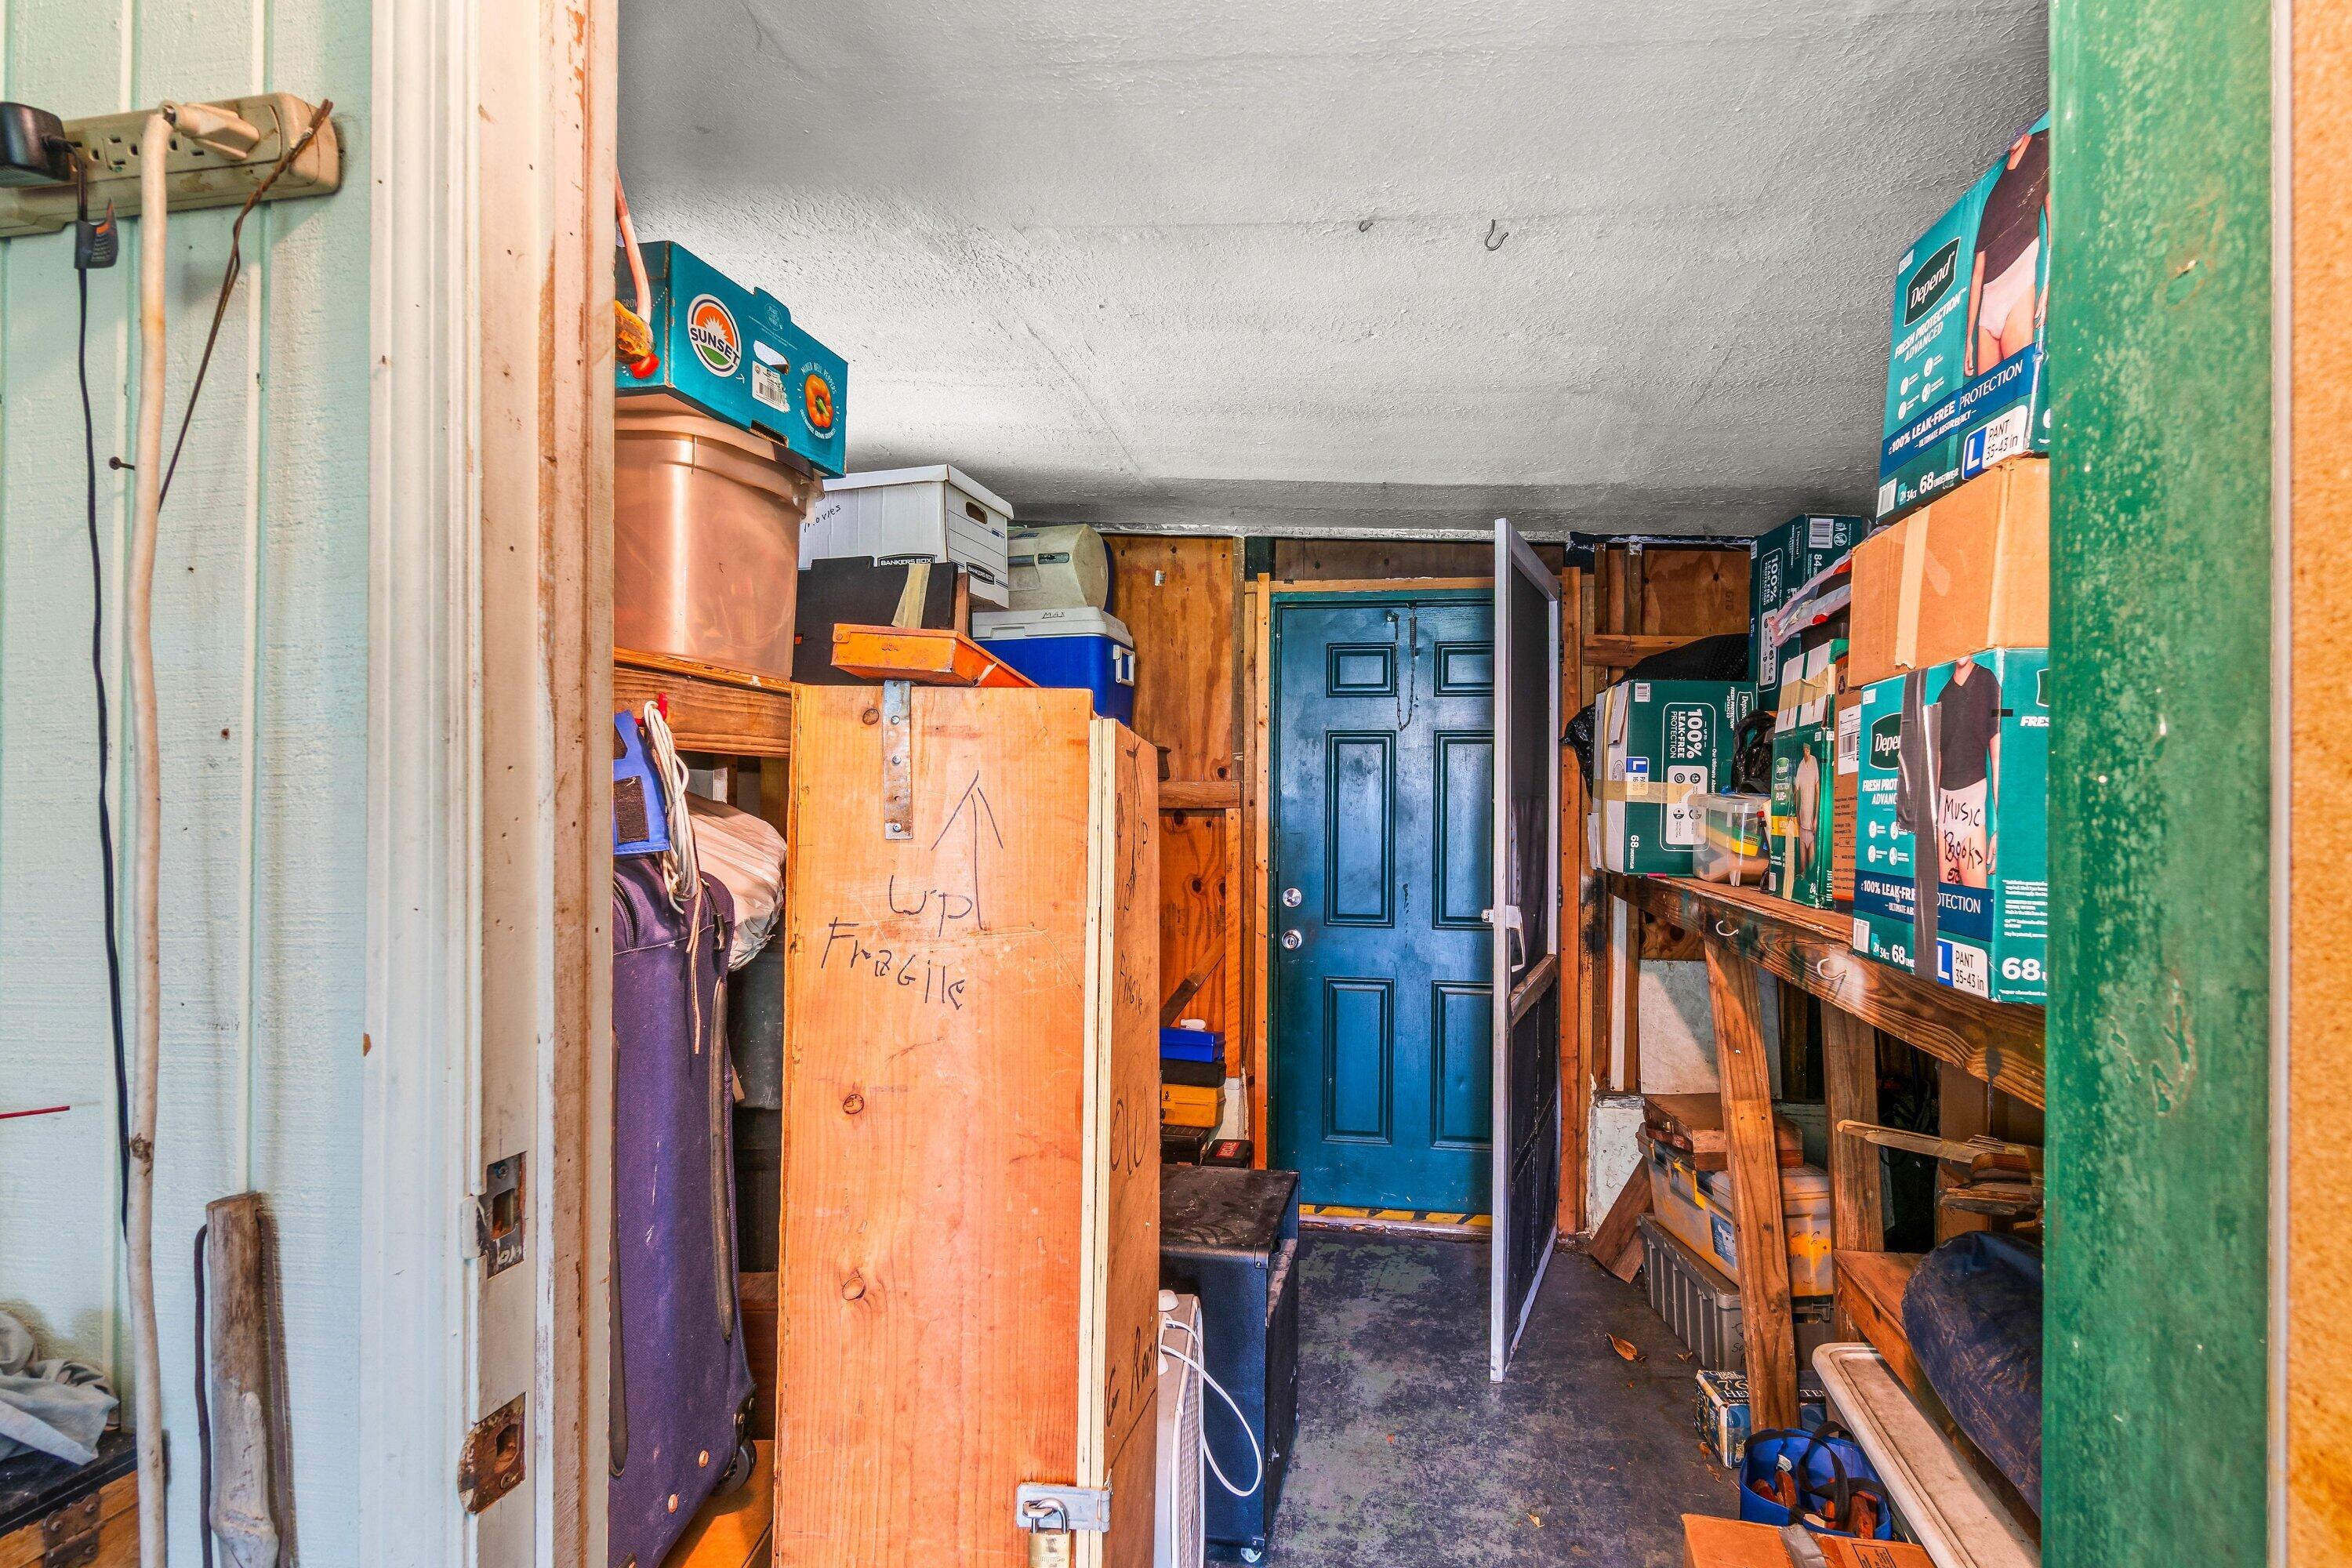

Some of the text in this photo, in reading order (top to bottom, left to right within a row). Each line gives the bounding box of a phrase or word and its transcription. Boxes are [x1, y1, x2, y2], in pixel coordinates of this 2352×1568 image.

[1910, 257, 1952, 309] Depend
[1894, 292, 1962, 360] FRESH PROTECTION
[690, 327, 740, 365] SUNSET
[1904, 321, 1944, 364] ADVANCED
[823, 368, 837, 394] PEPPERS
[1892, 359, 2024, 453] 100% LEAK-FREE PROTECTION
[1987, 419, 2010, 442] PANT
[1966, 434, 2018, 471] L 35-43 in
[1919, 471, 1934, 495] 68
[967, 565, 994, 582] BANKERS BOX
[1813, 554, 1823, 567] 84
[1769, 554, 1778, 602] 100%
[1686, 709, 1703, 759] 100%
[2020, 716, 2049, 727] FRE
[1677, 711, 1686, 759] LEAK-FREE
[1875, 733, 1901, 757] Depe
[1632, 760, 1646, 771] L
[1862, 779, 1881, 793] FRESH
[1871, 792, 1897, 805] ADVANC
[1630, 834, 1639, 848] 68
[1864, 880, 1881, 895] 100%
[1882, 883, 1915, 902] LEAK-FRE
[1937, 892, 1981, 914] TECTION
[1891, 944, 1905, 966] 68
[1955, 949, 1974, 968] PANT
[1938, 945, 1984, 992] L 35-43 in
[2002, 956, 2041, 982] 68
